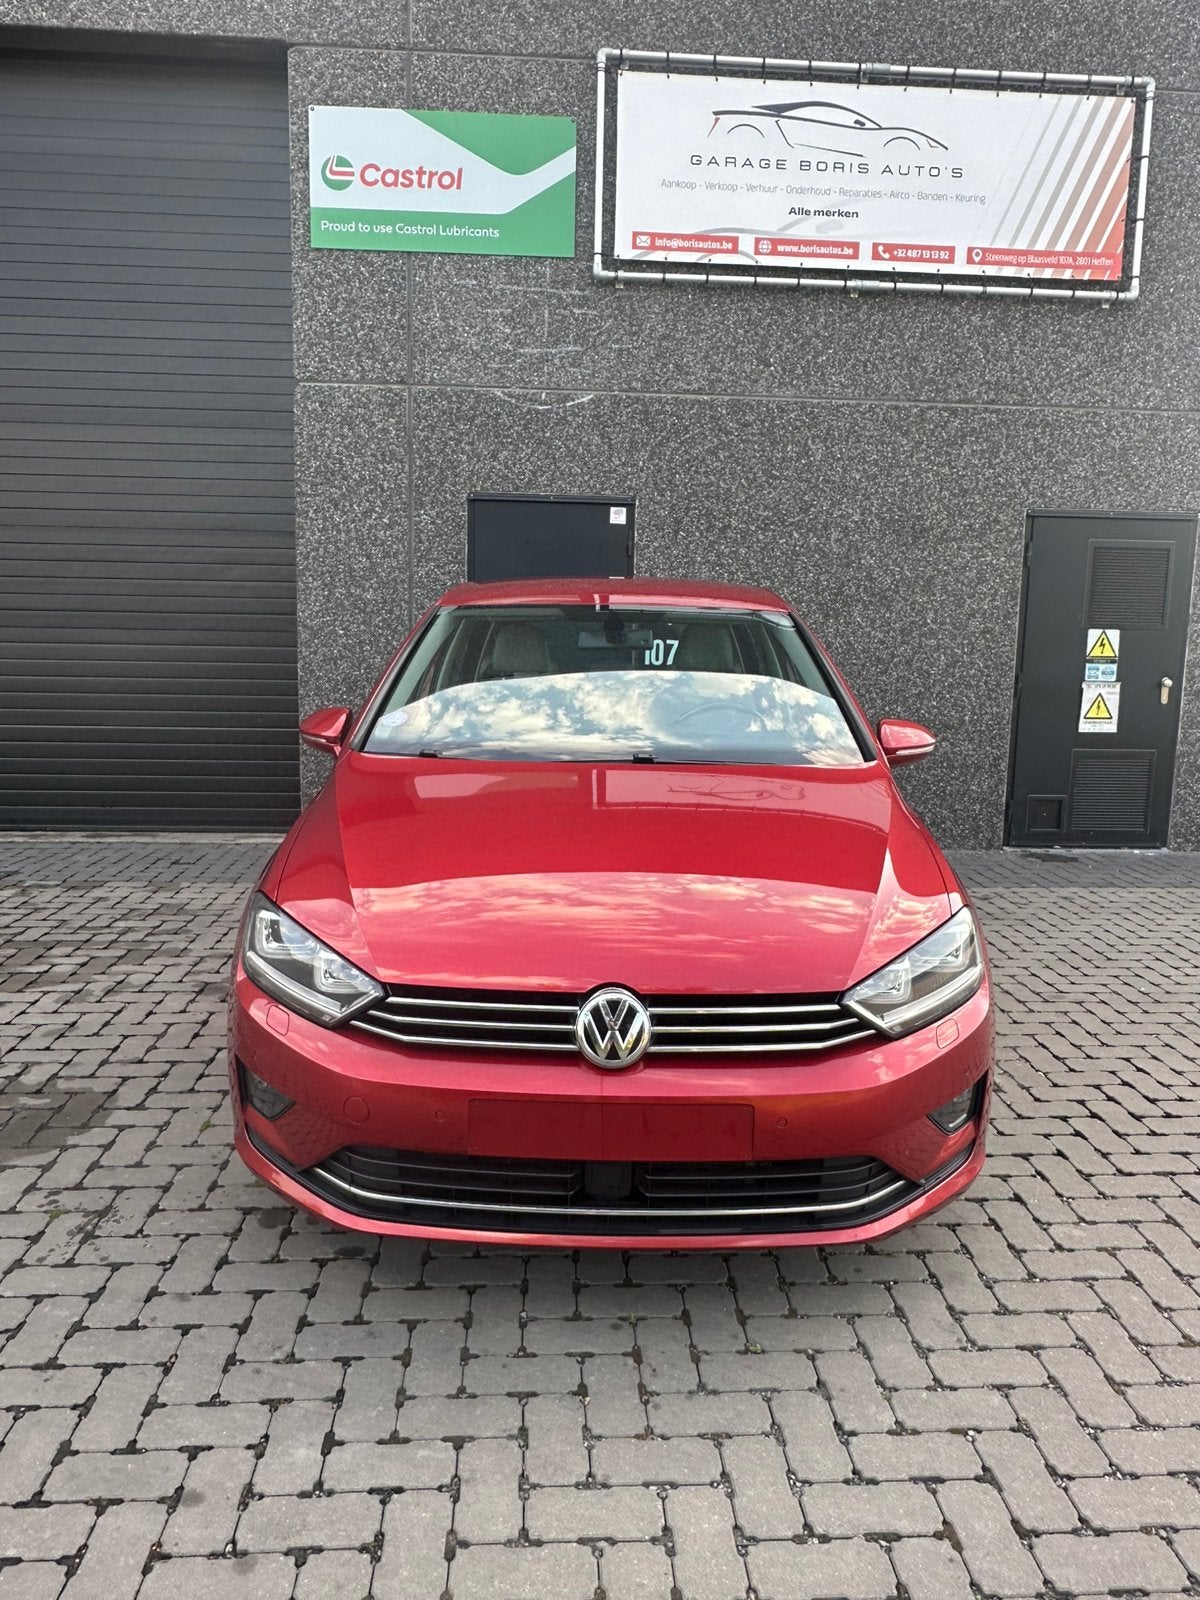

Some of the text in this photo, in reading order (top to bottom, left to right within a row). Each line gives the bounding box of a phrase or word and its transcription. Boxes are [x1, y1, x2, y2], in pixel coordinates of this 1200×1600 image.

[691, 155, 963, 178] GARAGE BORIS AUTO'S
[359, 162, 463, 190] Castrol
[661, 178, 697, 190] Aankoop
[704, 181, 738, 192] Verkoop
[745, 183, 778, 193] Verhuur
[785, 184, 831, 196] Onderhoud
[838, 187, 882, 199] Reparaties
[889, 190, 910, 200] Airco
[917, 192, 948, 201] Banden
[955, 193, 986, 205] Keuring
[788, 206, 859, 219] Alle merken
[320, 220, 500, 238] Proud to use Castrol Lubricants
[655, 237, 733, 249] info@borisautos.be
[777, 244, 854, 255] www.borisautos.be
[893, 248, 950, 259] +32 487 13 13 92
[985, 252, 1018, 264] Steenweg
[1018, 256, 1026, 264] op
